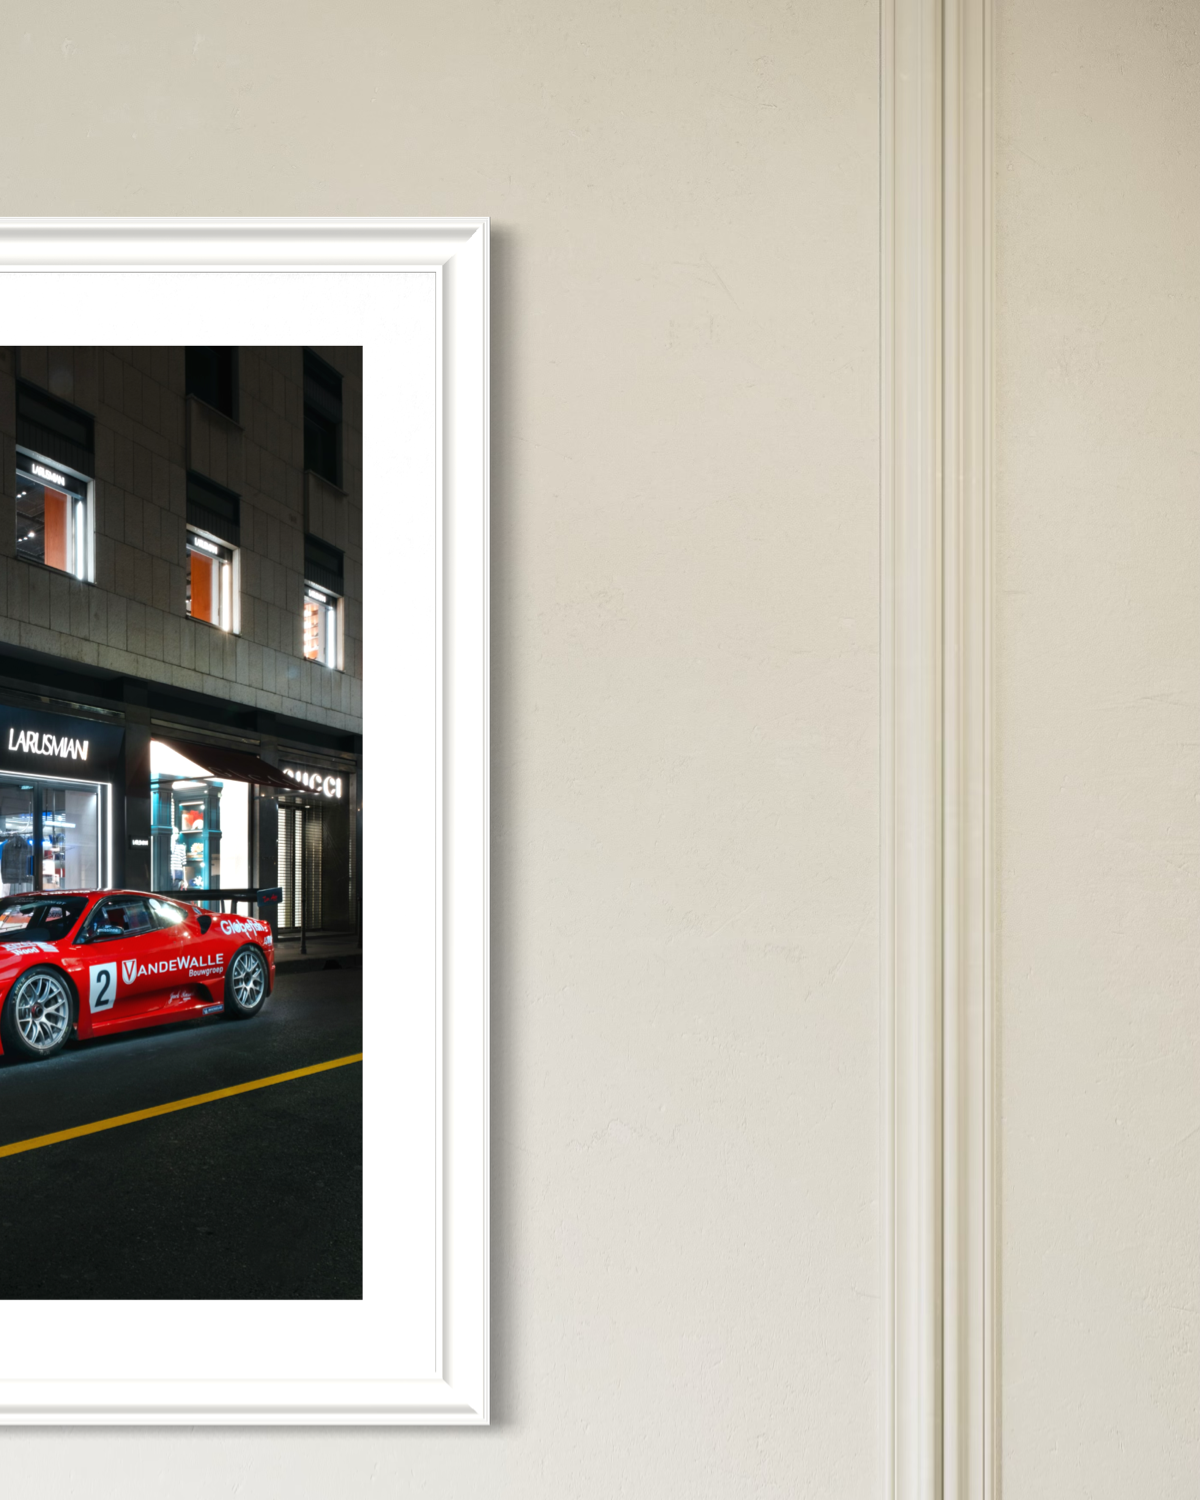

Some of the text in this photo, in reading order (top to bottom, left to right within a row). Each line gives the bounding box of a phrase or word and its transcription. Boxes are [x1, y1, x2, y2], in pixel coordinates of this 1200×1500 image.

[8, 728, 89, 761] LARUSMIANI
[189, 966, 224, 977] Bouwgroep
[95, 969, 110, 1008] 2
